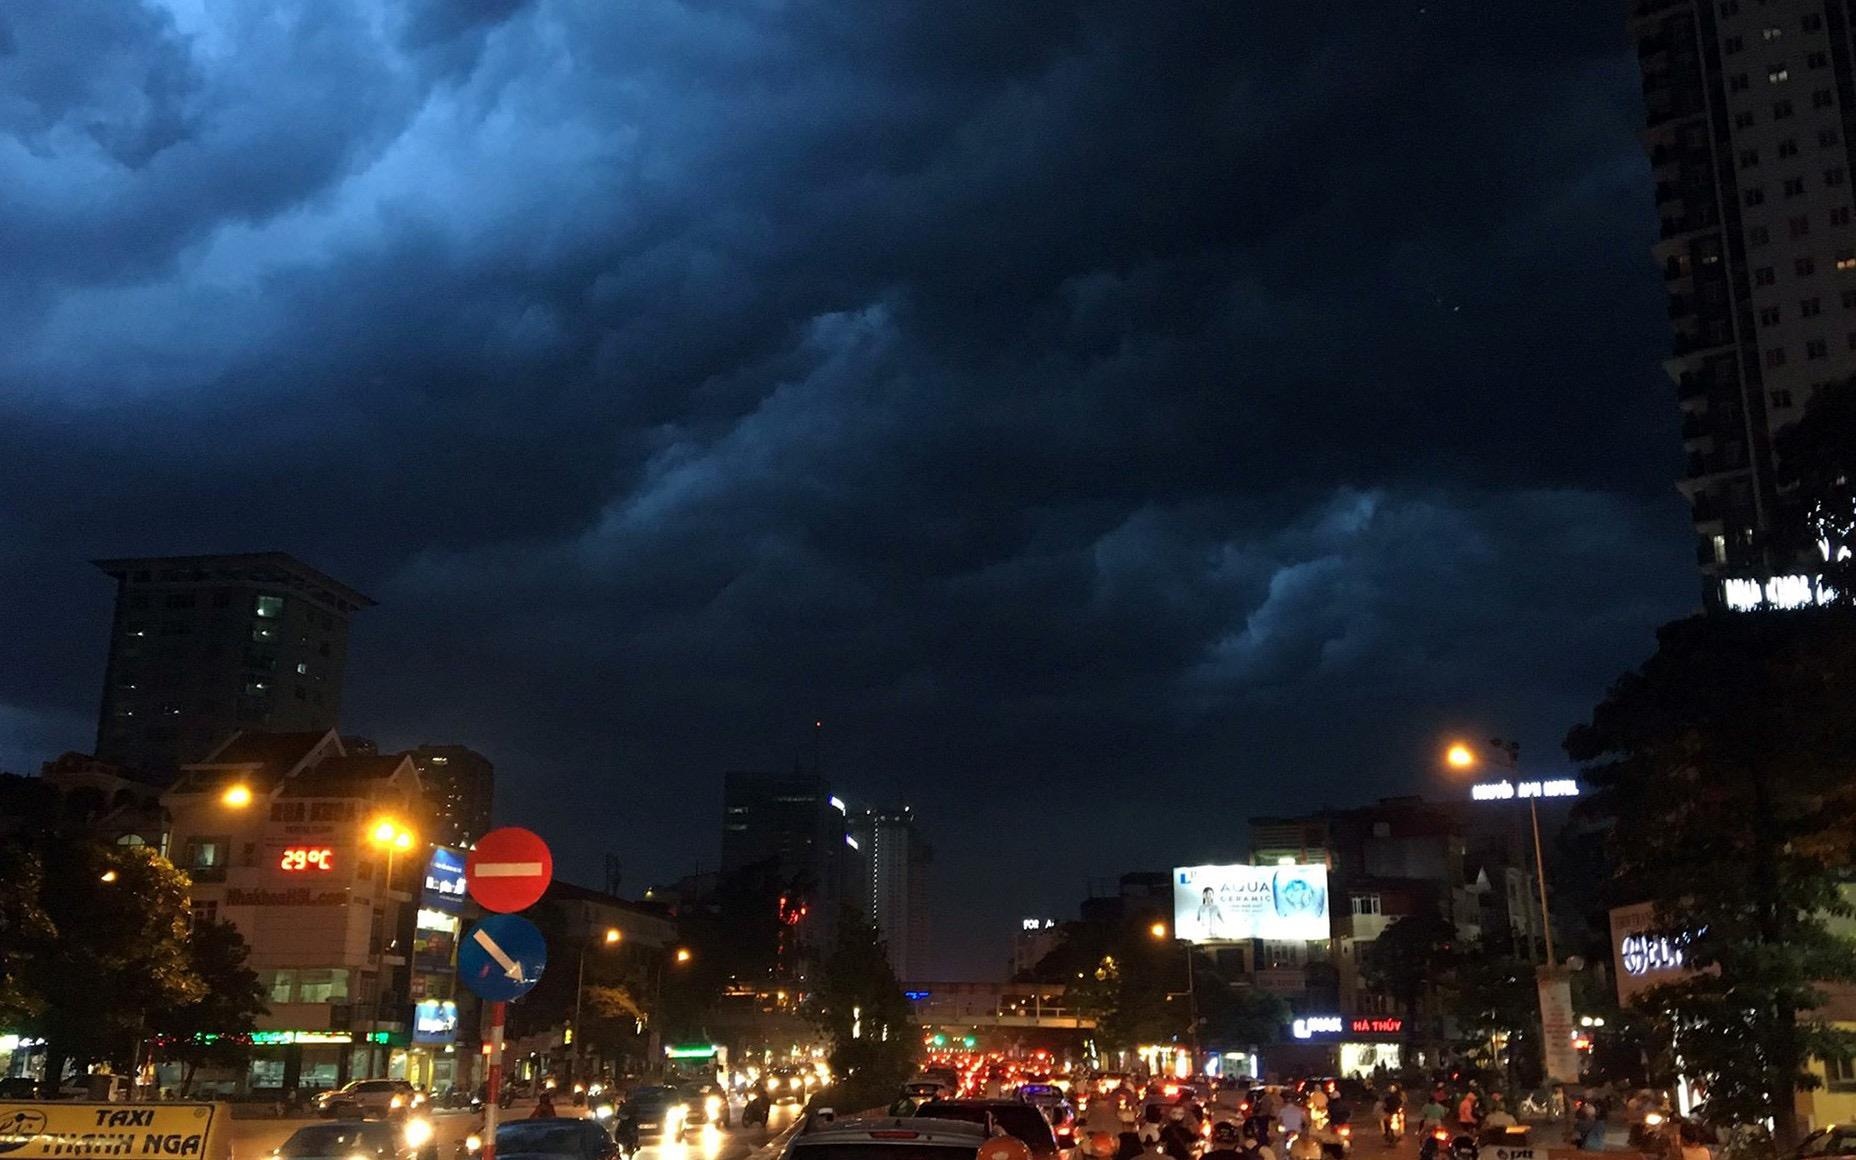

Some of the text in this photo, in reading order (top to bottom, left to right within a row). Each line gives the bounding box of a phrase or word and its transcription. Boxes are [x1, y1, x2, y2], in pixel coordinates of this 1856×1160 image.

[1220, 881, 1271, 893] AQUA
[95, 1110, 155, 1127] TAXI
[142, 1135, 201, 1157] NGA
